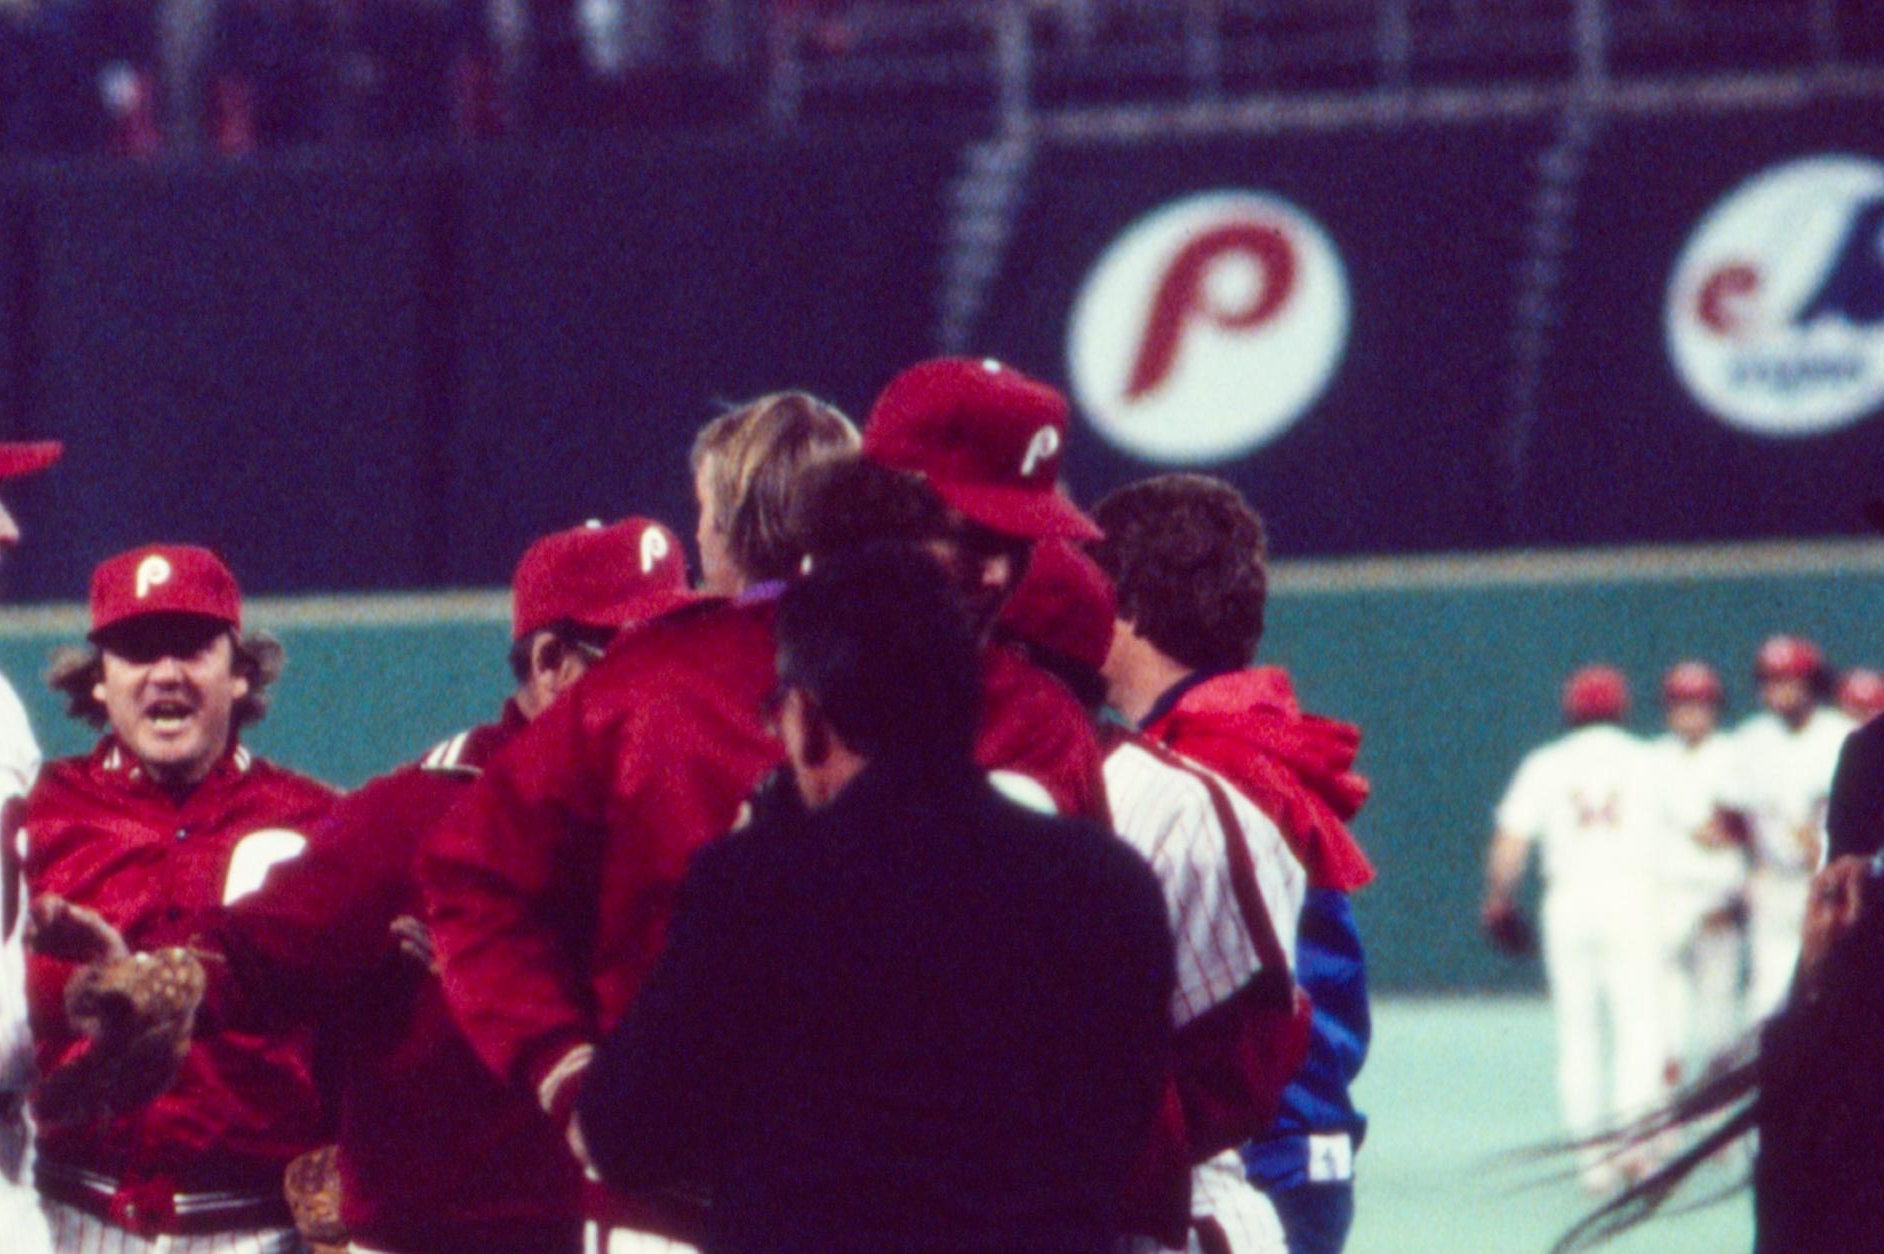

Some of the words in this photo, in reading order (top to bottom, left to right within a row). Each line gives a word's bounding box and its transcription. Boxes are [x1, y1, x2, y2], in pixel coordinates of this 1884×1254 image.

[1123, 222, 1298, 402] P
[1020, 424, 1058, 477] P
[639, 525, 668, 574] P
[136, 554, 171, 599] P
